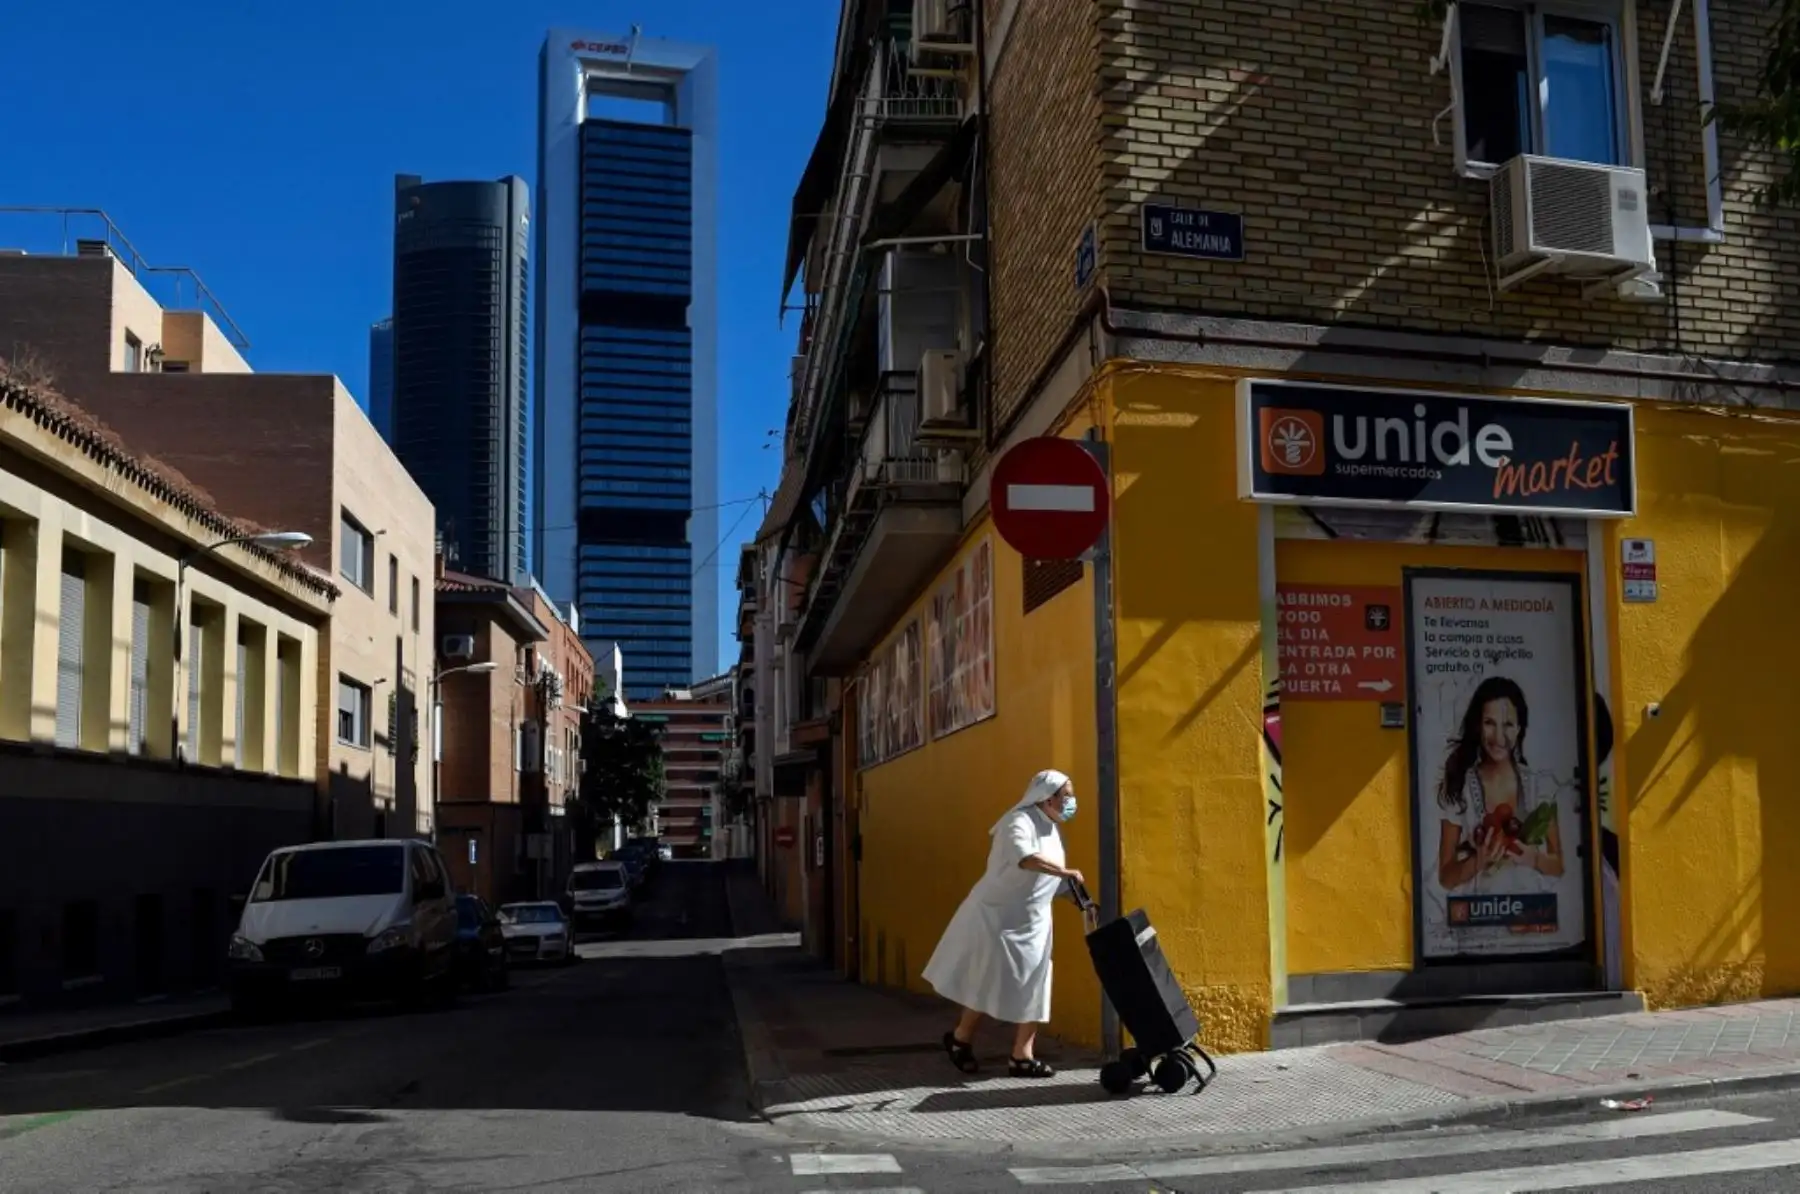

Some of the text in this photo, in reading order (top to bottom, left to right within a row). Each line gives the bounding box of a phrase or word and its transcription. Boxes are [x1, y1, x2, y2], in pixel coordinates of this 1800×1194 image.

[1171, 229, 1232, 254] ALEMANIA
[1332, 403, 1513, 468] unide
[1335, 462, 1443, 480] supermercados
[1493, 440, 1619, 499] market
[1276, 593, 1352, 607] ABRIMOS
[1424, 596, 1555, 613] ABIERTO A MEDIODÍA
[1278, 611, 1321, 623] TODO
[1424, 616, 1489, 629] Te llevamos
[1301, 628, 1329, 640] DIA
[1424, 631, 1435, 643] la
[1439, 633, 1483, 645] compra
[1486, 635, 1494, 644] a
[1278, 645, 1396, 659] ENTRADA POR
[1425, 646, 1470, 659] Servicio
[1472, 648, 1481, 659] a
[1305, 663, 1352, 676] OTRA
[1279, 680, 1342, 693] PUERTA
[1470, 896, 1523, 916] unide
